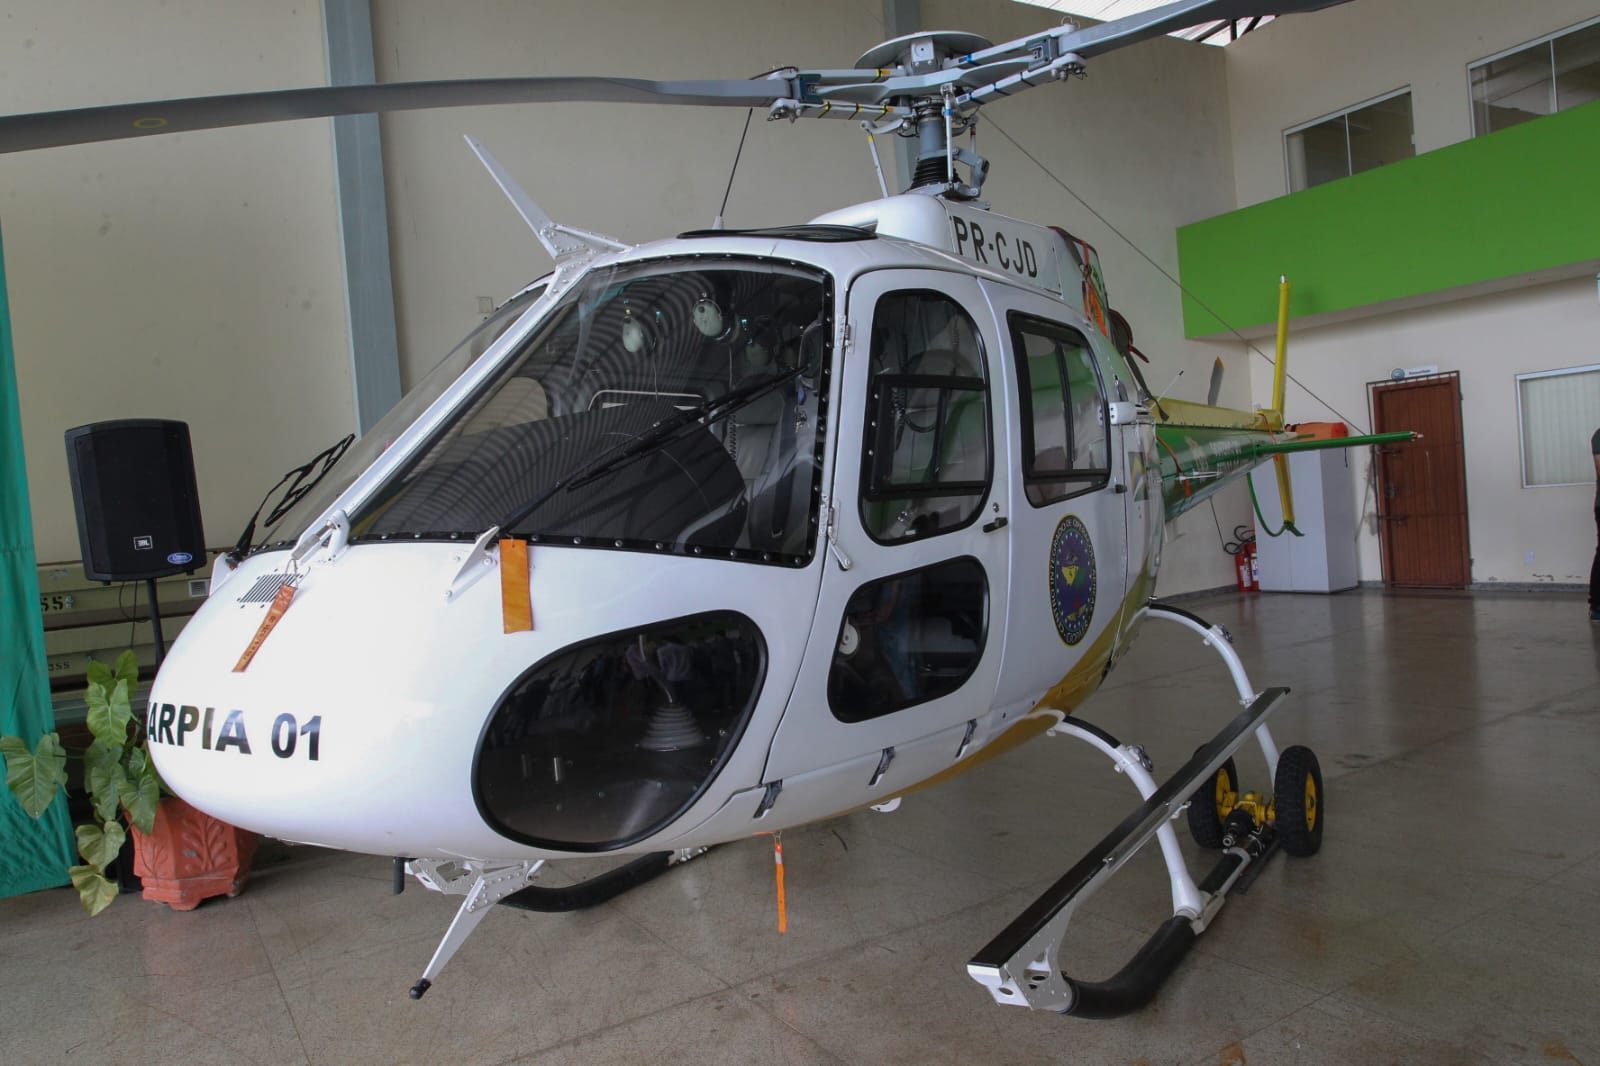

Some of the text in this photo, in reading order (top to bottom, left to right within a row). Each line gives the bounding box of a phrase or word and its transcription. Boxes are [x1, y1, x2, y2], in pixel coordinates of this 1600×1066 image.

[953, 216, 1037, 277] PR-CJD
[147, 701, 322, 762] ARPIA 01
